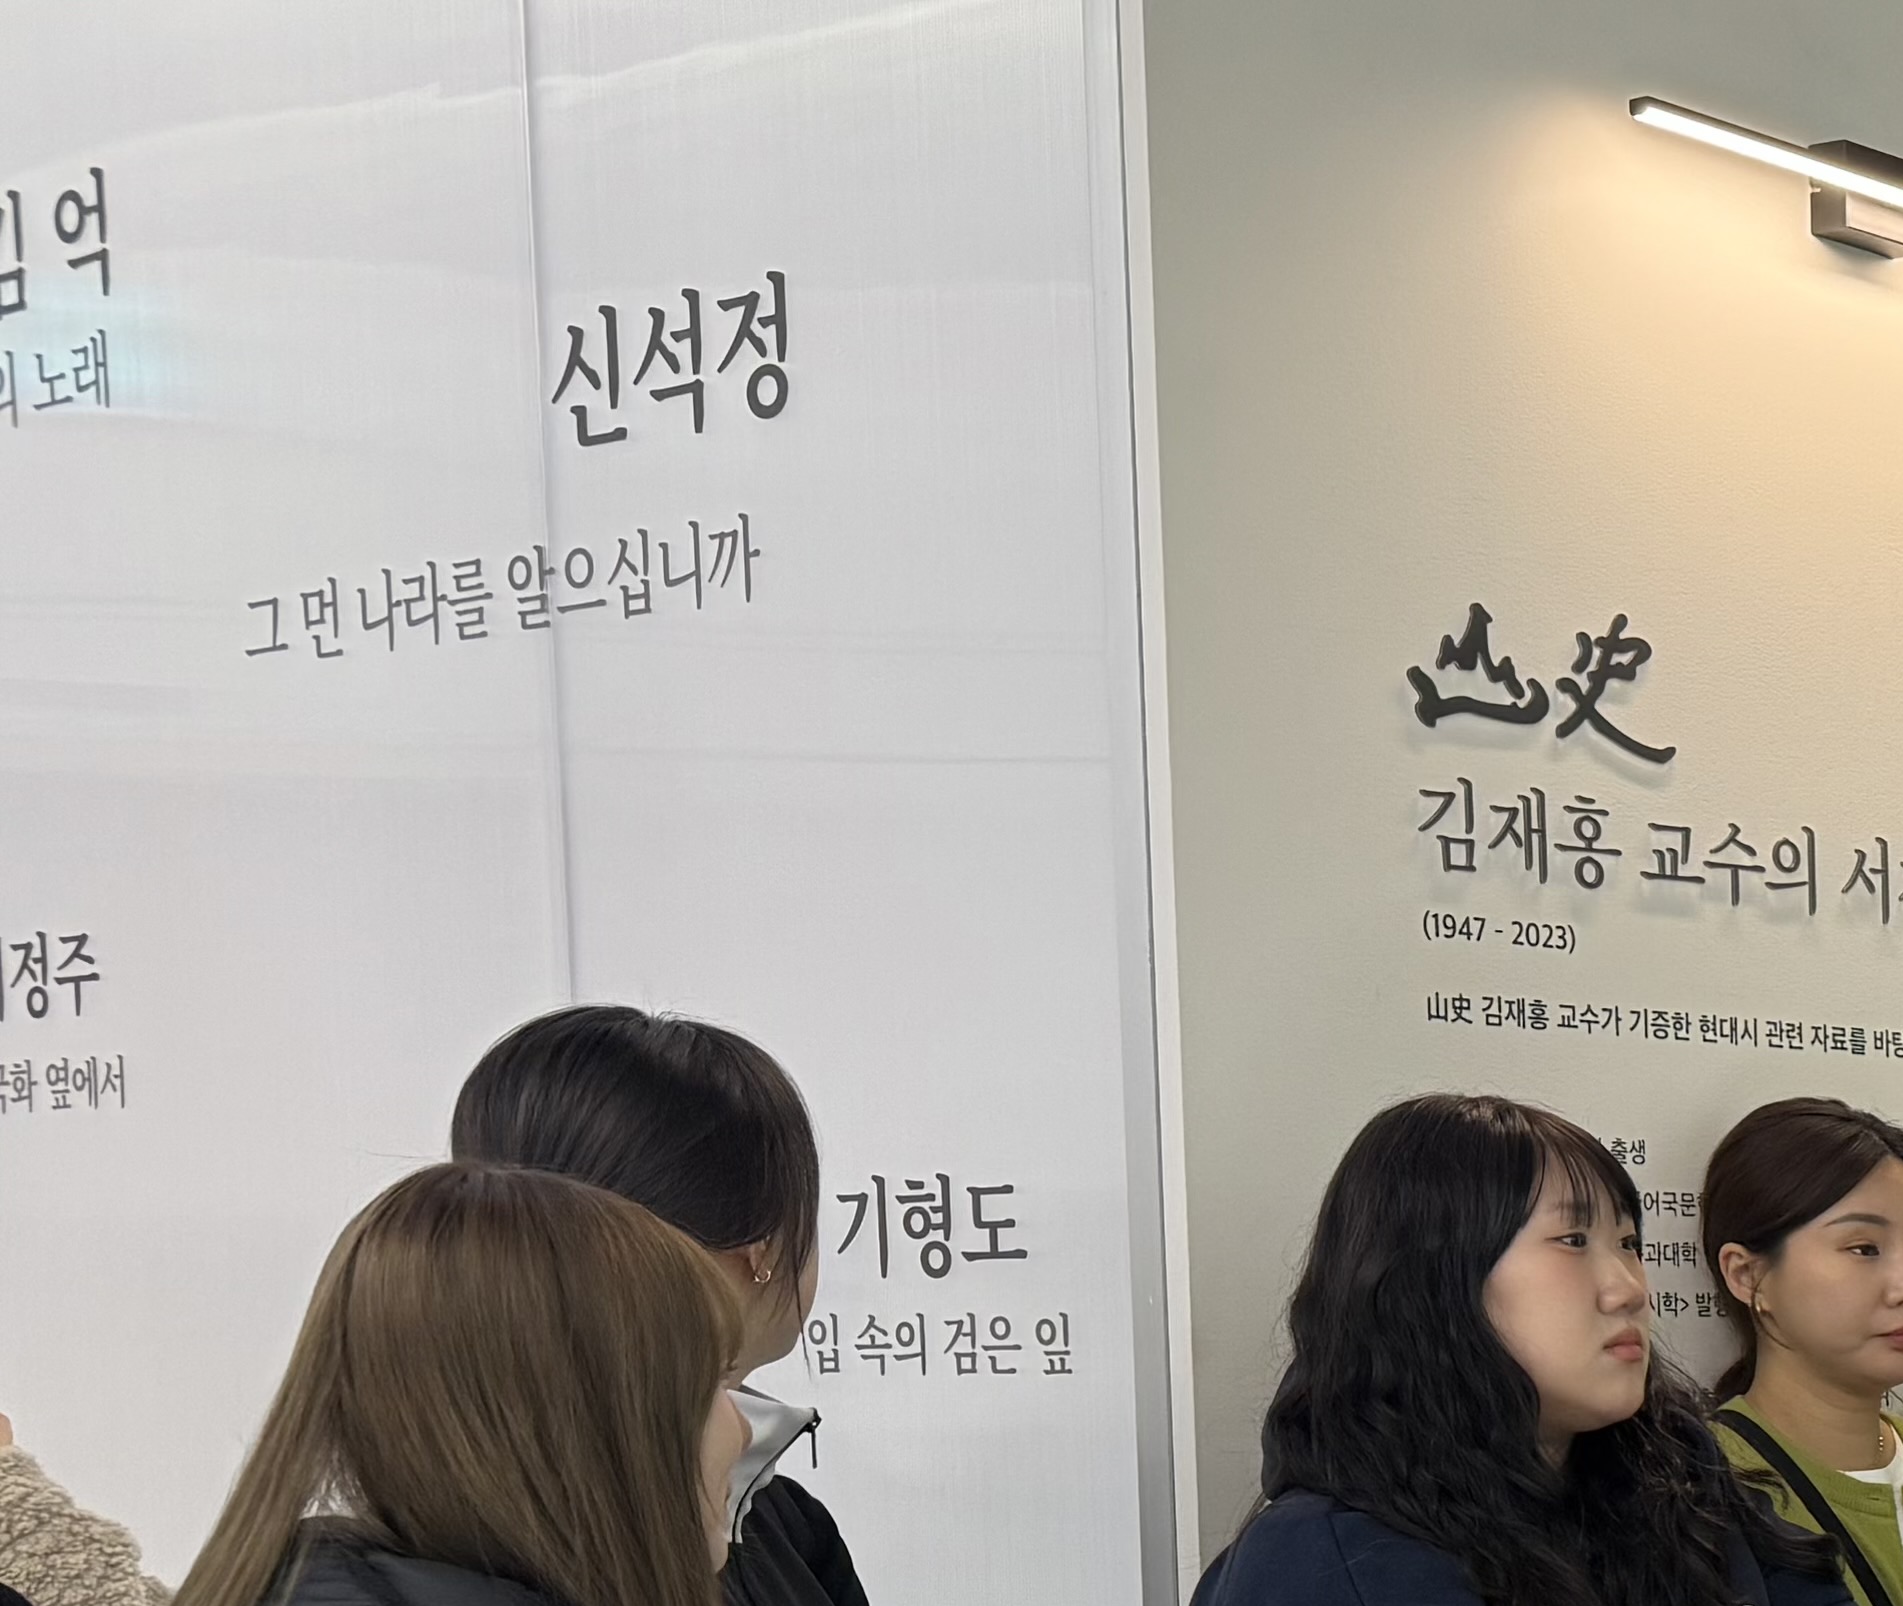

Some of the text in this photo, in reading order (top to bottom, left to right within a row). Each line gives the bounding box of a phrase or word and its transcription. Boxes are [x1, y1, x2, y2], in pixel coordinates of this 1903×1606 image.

[33, 329, 110, 410] 노래
[550, 270, 790, 447] 신석정
[244, 512, 762, 659] 그 먼 나라를 알으십니까
[1417, 776, 1623, 891] 김재홍
[1639, 822, 1818, 917] 교수의
[1423, 910, 1486, 942] (1947
[1511, 920, 1576, 954] 2023)
[0, 931, 100, 1020] 정주
[1427, 991, 1473, 1025] 山史
[1481, 995, 1550, 1031] 김재홍
[1556, 1003, 1623, 1036] 교수가
[1629, 1007, 1691, 1042] 기증한
[1698, 1013, 1758, 1048] 현대시
[1765, 1020, 1804, 1052] 관련
[1810, 1024, 1868, 1056] 자료를
[46, 1054, 125, 1111] 옆에서
[1611, 1138, 1647, 1166] 출생
[836, 1173, 1029, 1279] 기형도
[1637, 1190, 1706, 1218] 어국문
[1644, 1241, 1697, 1268] 과대학
[808, 1311, 1073, 1376] 입 속의 검은 잎
